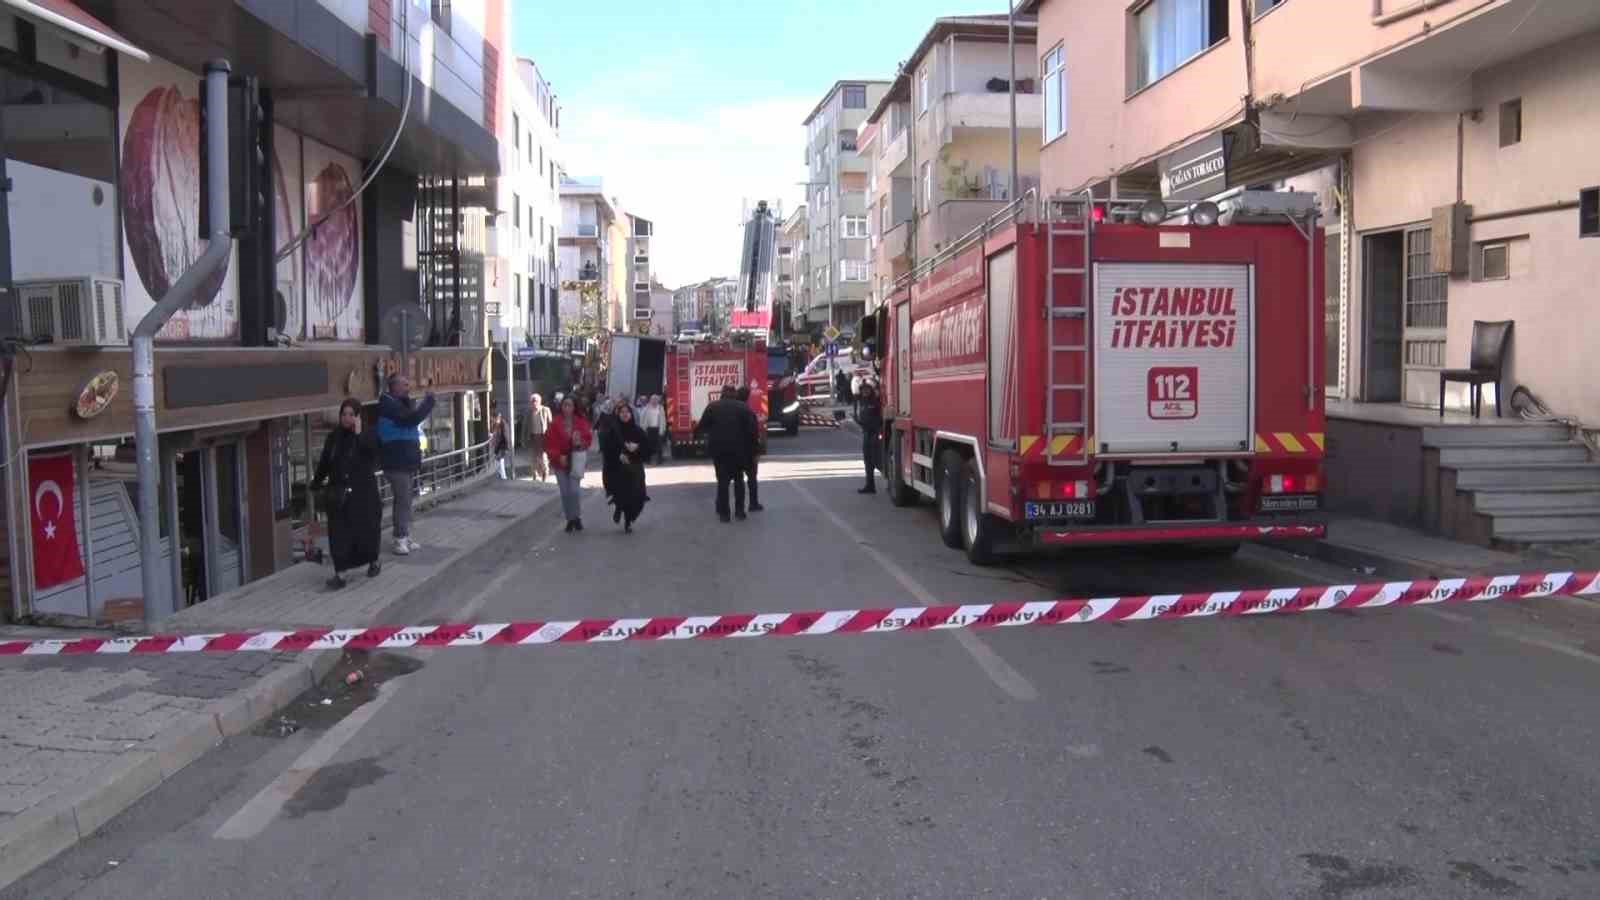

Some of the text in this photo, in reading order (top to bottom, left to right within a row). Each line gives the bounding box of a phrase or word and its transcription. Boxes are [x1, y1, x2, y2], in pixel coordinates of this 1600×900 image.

[1192, 156, 1224, 178] TOBACCO
[1155, 374, 1190, 399] 112
[1033, 503, 1046, 516] 34
[1050, 504, 1063, 515] AJ
[876, 615, 967, 629] İTFAİYESİ
